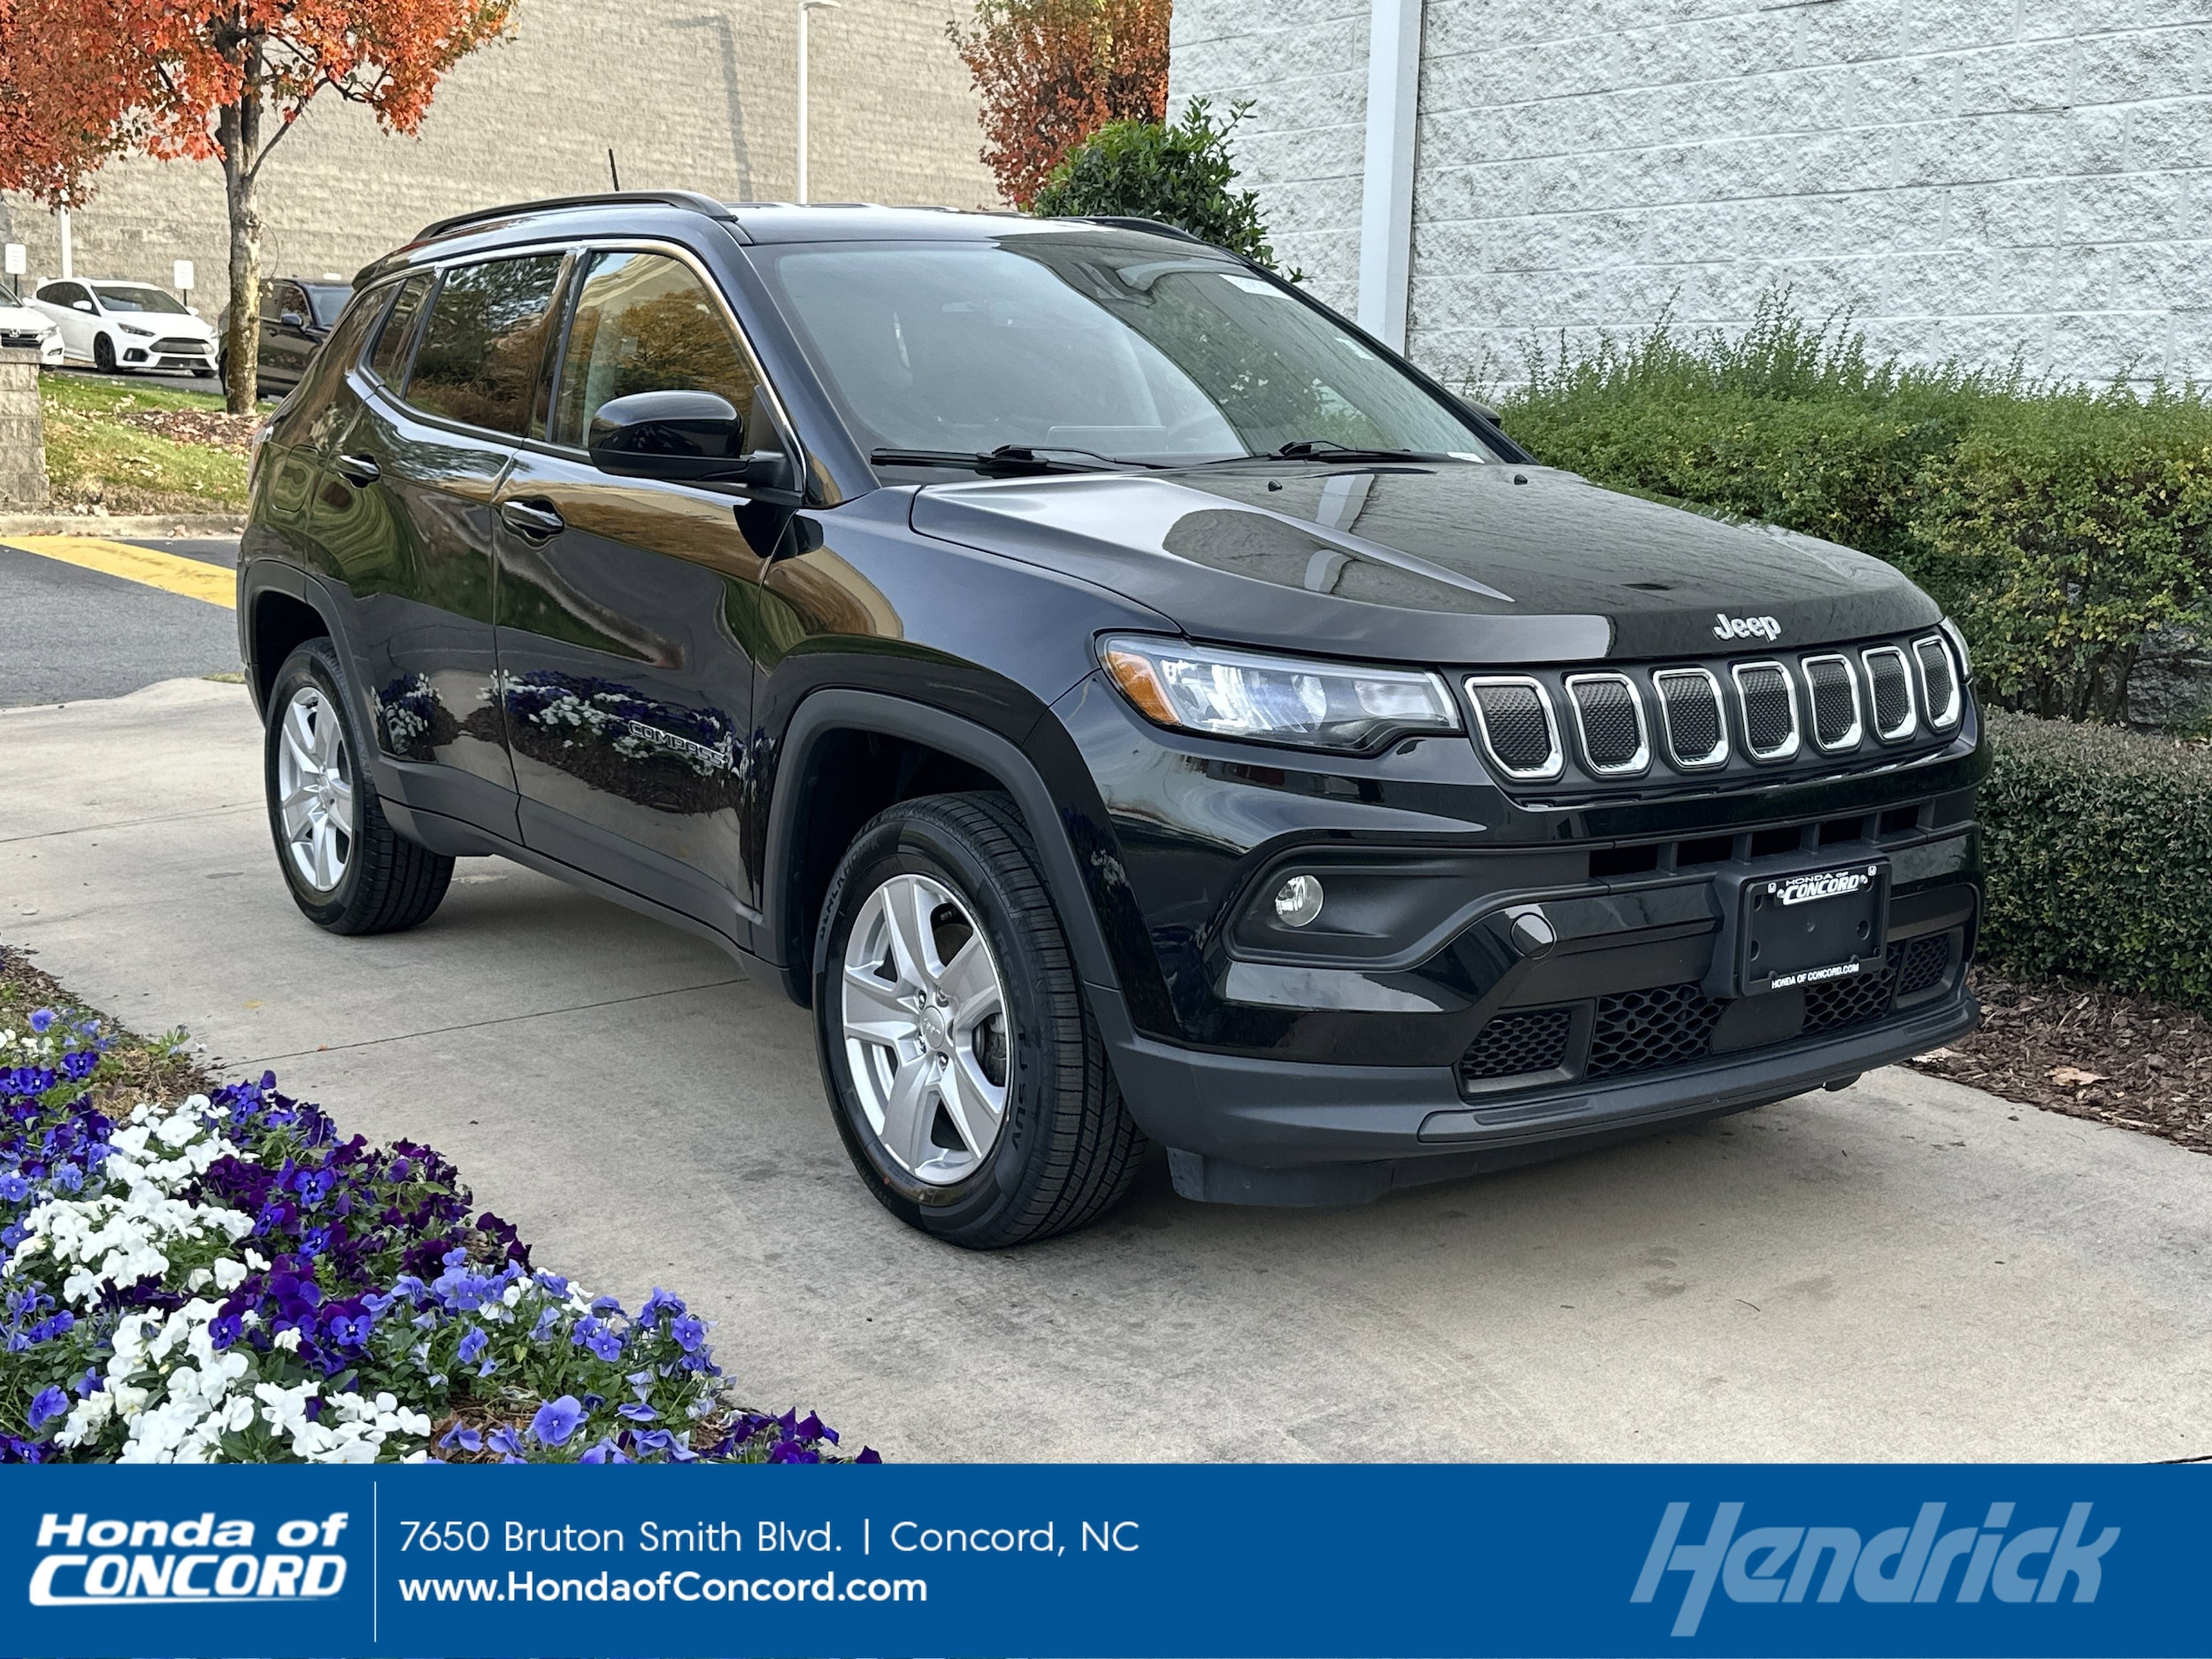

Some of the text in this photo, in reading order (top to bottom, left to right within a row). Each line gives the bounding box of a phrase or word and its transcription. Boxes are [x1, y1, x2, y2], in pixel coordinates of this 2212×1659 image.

[1713, 613, 1782, 641] Jeep
[628, 719, 726, 769] COMPASS
[1783, 874, 1859, 905] CONCORD
[1786, 873, 1833, 887] HONDA
[1771, 963, 1859, 989] HONDA OF CONCORD.COM
